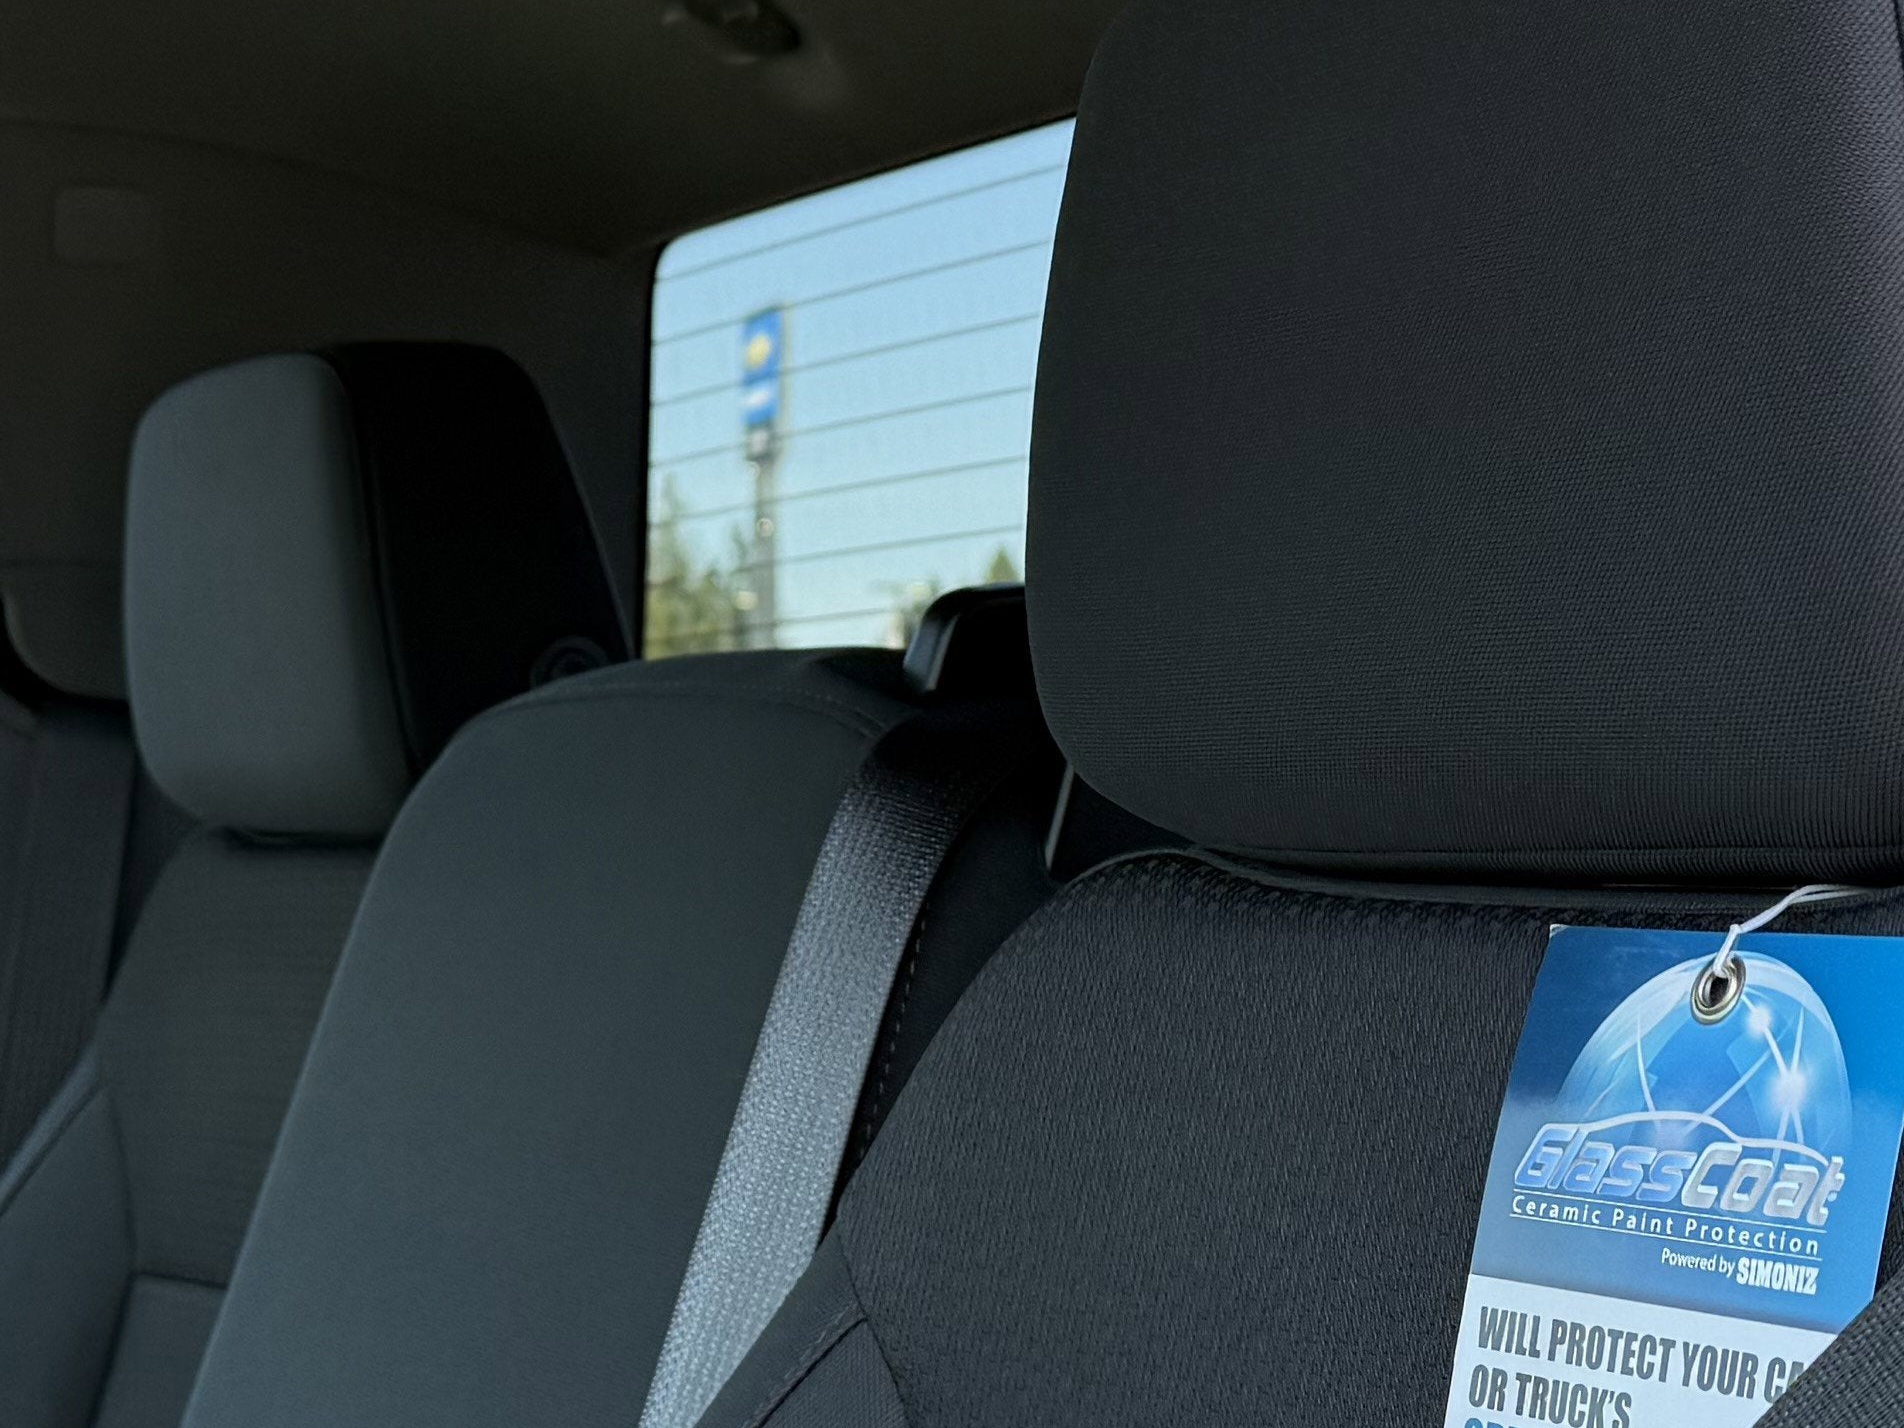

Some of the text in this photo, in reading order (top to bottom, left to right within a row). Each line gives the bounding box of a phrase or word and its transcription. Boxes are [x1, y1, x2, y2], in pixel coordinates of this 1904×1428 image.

[1514, 1124, 1846, 1227] GlassCoat
[1512, 1195, 1819, 1256] Ceramic Paint Protection
[1660, 1247, 1821, 1295] Powered by SIMONIZ
[1478, 1306, 1541, 1358] WILL
[1547, 1318, 1677, 1383] PROTECT
[1681, 1341, 1759, 1400] YOUR
[1468, 1364, 1508, 1412] OR
